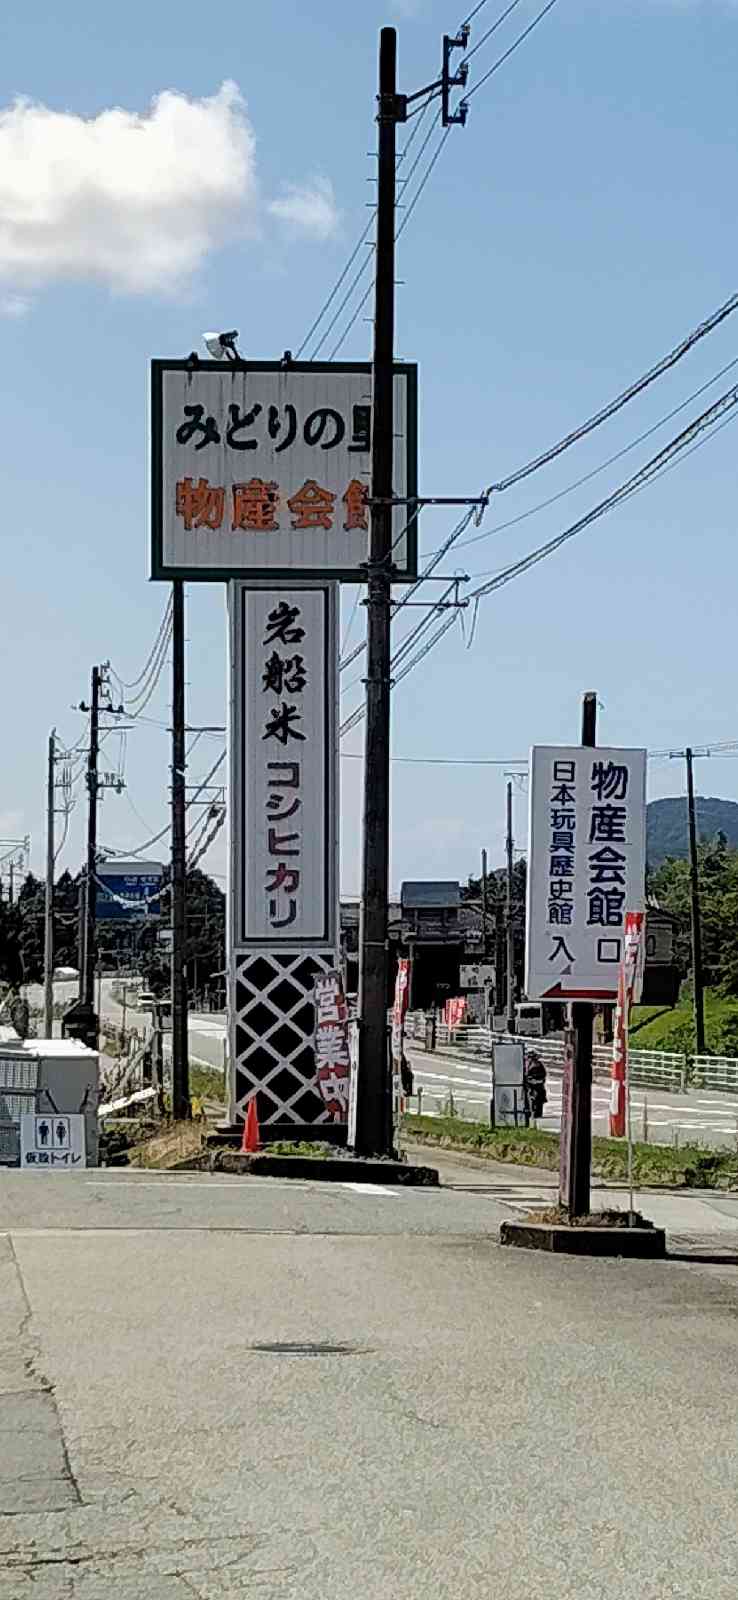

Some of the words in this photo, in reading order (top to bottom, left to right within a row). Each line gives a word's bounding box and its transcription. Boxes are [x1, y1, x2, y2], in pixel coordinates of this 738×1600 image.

[548, 760, 576, 926] 日本玩具歴史館
[586, 760, 628, 927] 物産会館
[316, 976, 349, 1122] 営業中
[26, 1151, 81, 1165] 仮設トイレ
